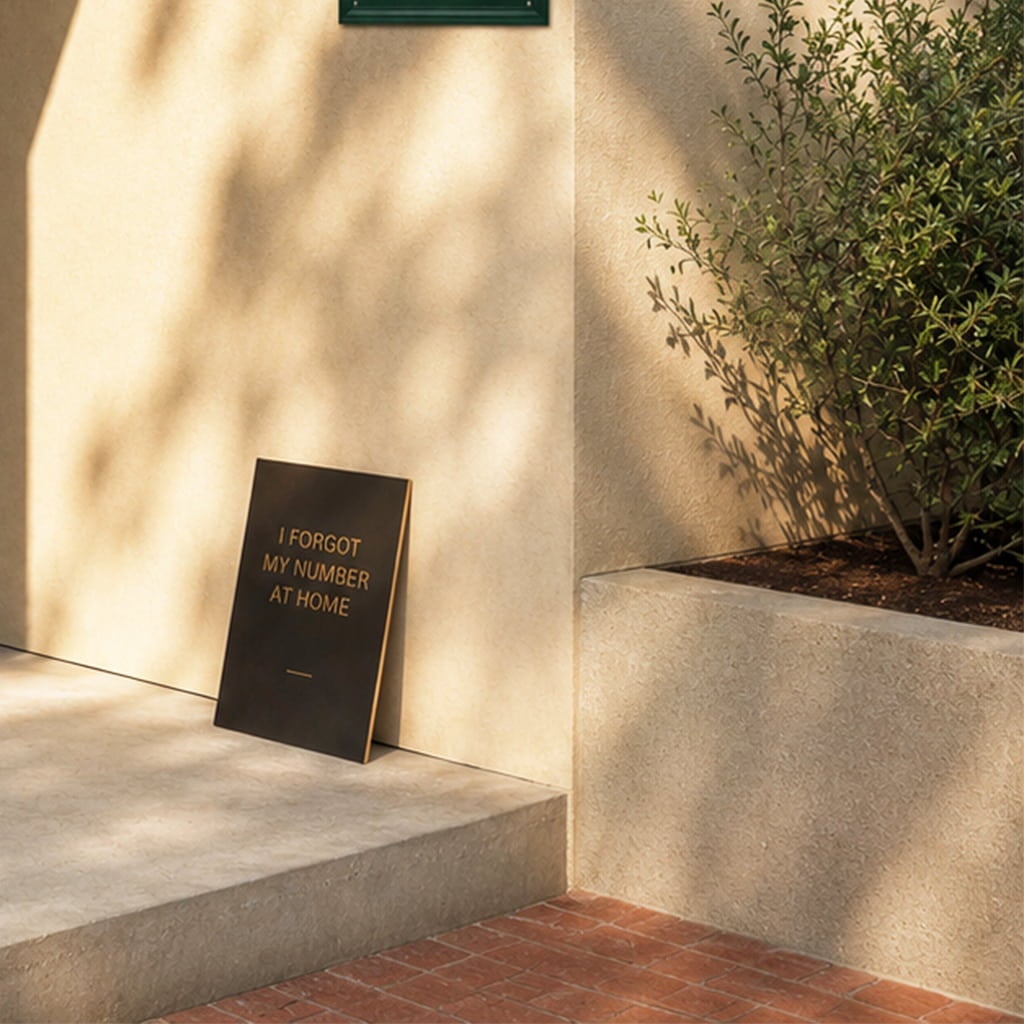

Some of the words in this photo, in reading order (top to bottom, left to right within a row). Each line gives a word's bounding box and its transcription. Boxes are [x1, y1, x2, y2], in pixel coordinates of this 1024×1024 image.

[278, 527, 286, 545] I
[289, 528, 361, 558] FORGOT
[262, 553, 290, 574] MY
[293, 559, 370, 590] NUMBER
[269, 585, 293, 605] AT
[296, 590, 351, 617] HOME
